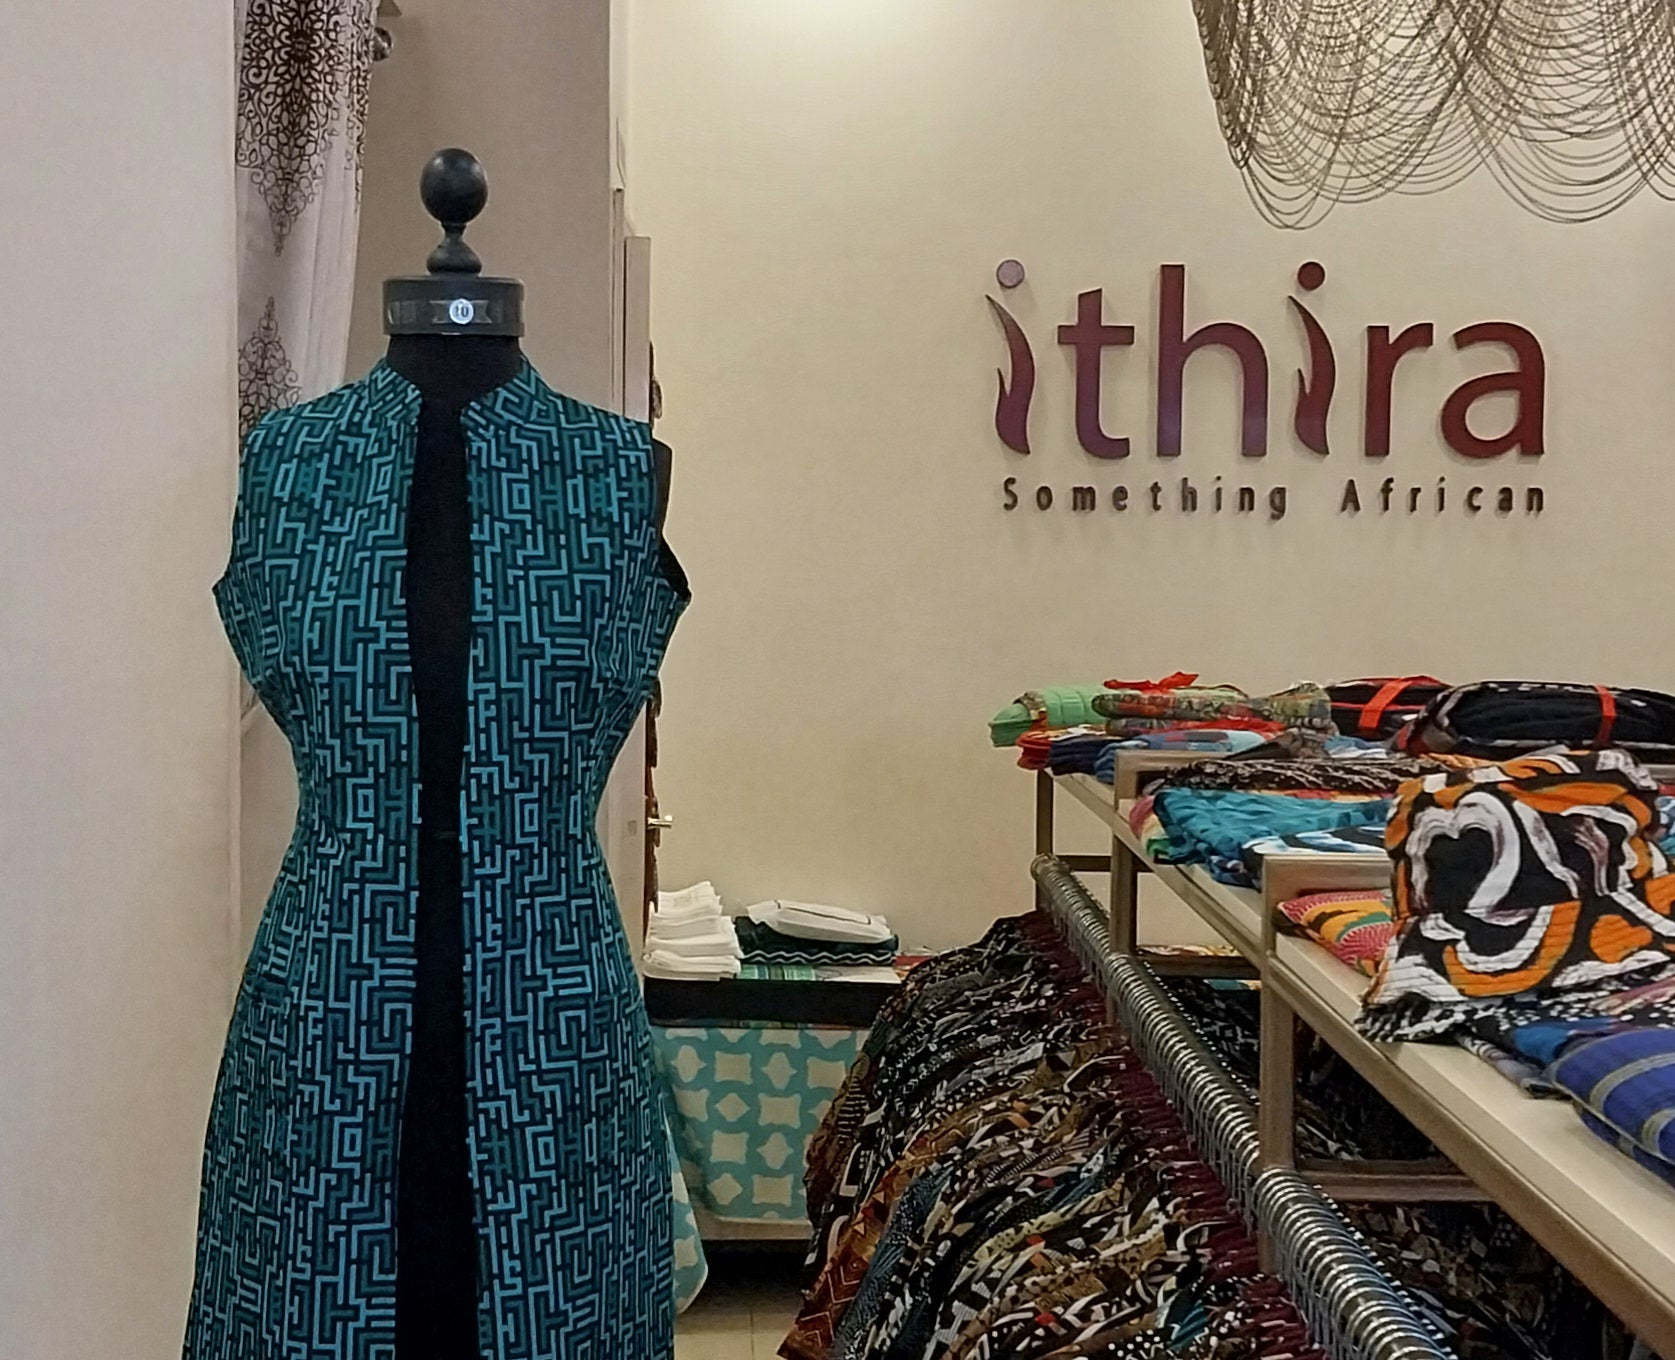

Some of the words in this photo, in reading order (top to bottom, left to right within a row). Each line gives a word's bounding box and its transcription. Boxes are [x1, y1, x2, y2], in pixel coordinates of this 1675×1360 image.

[985, 259, 1545, 459] ithira
[1002, 476, 1288, 520] Something
[1340, 476, 1545, 516] African
